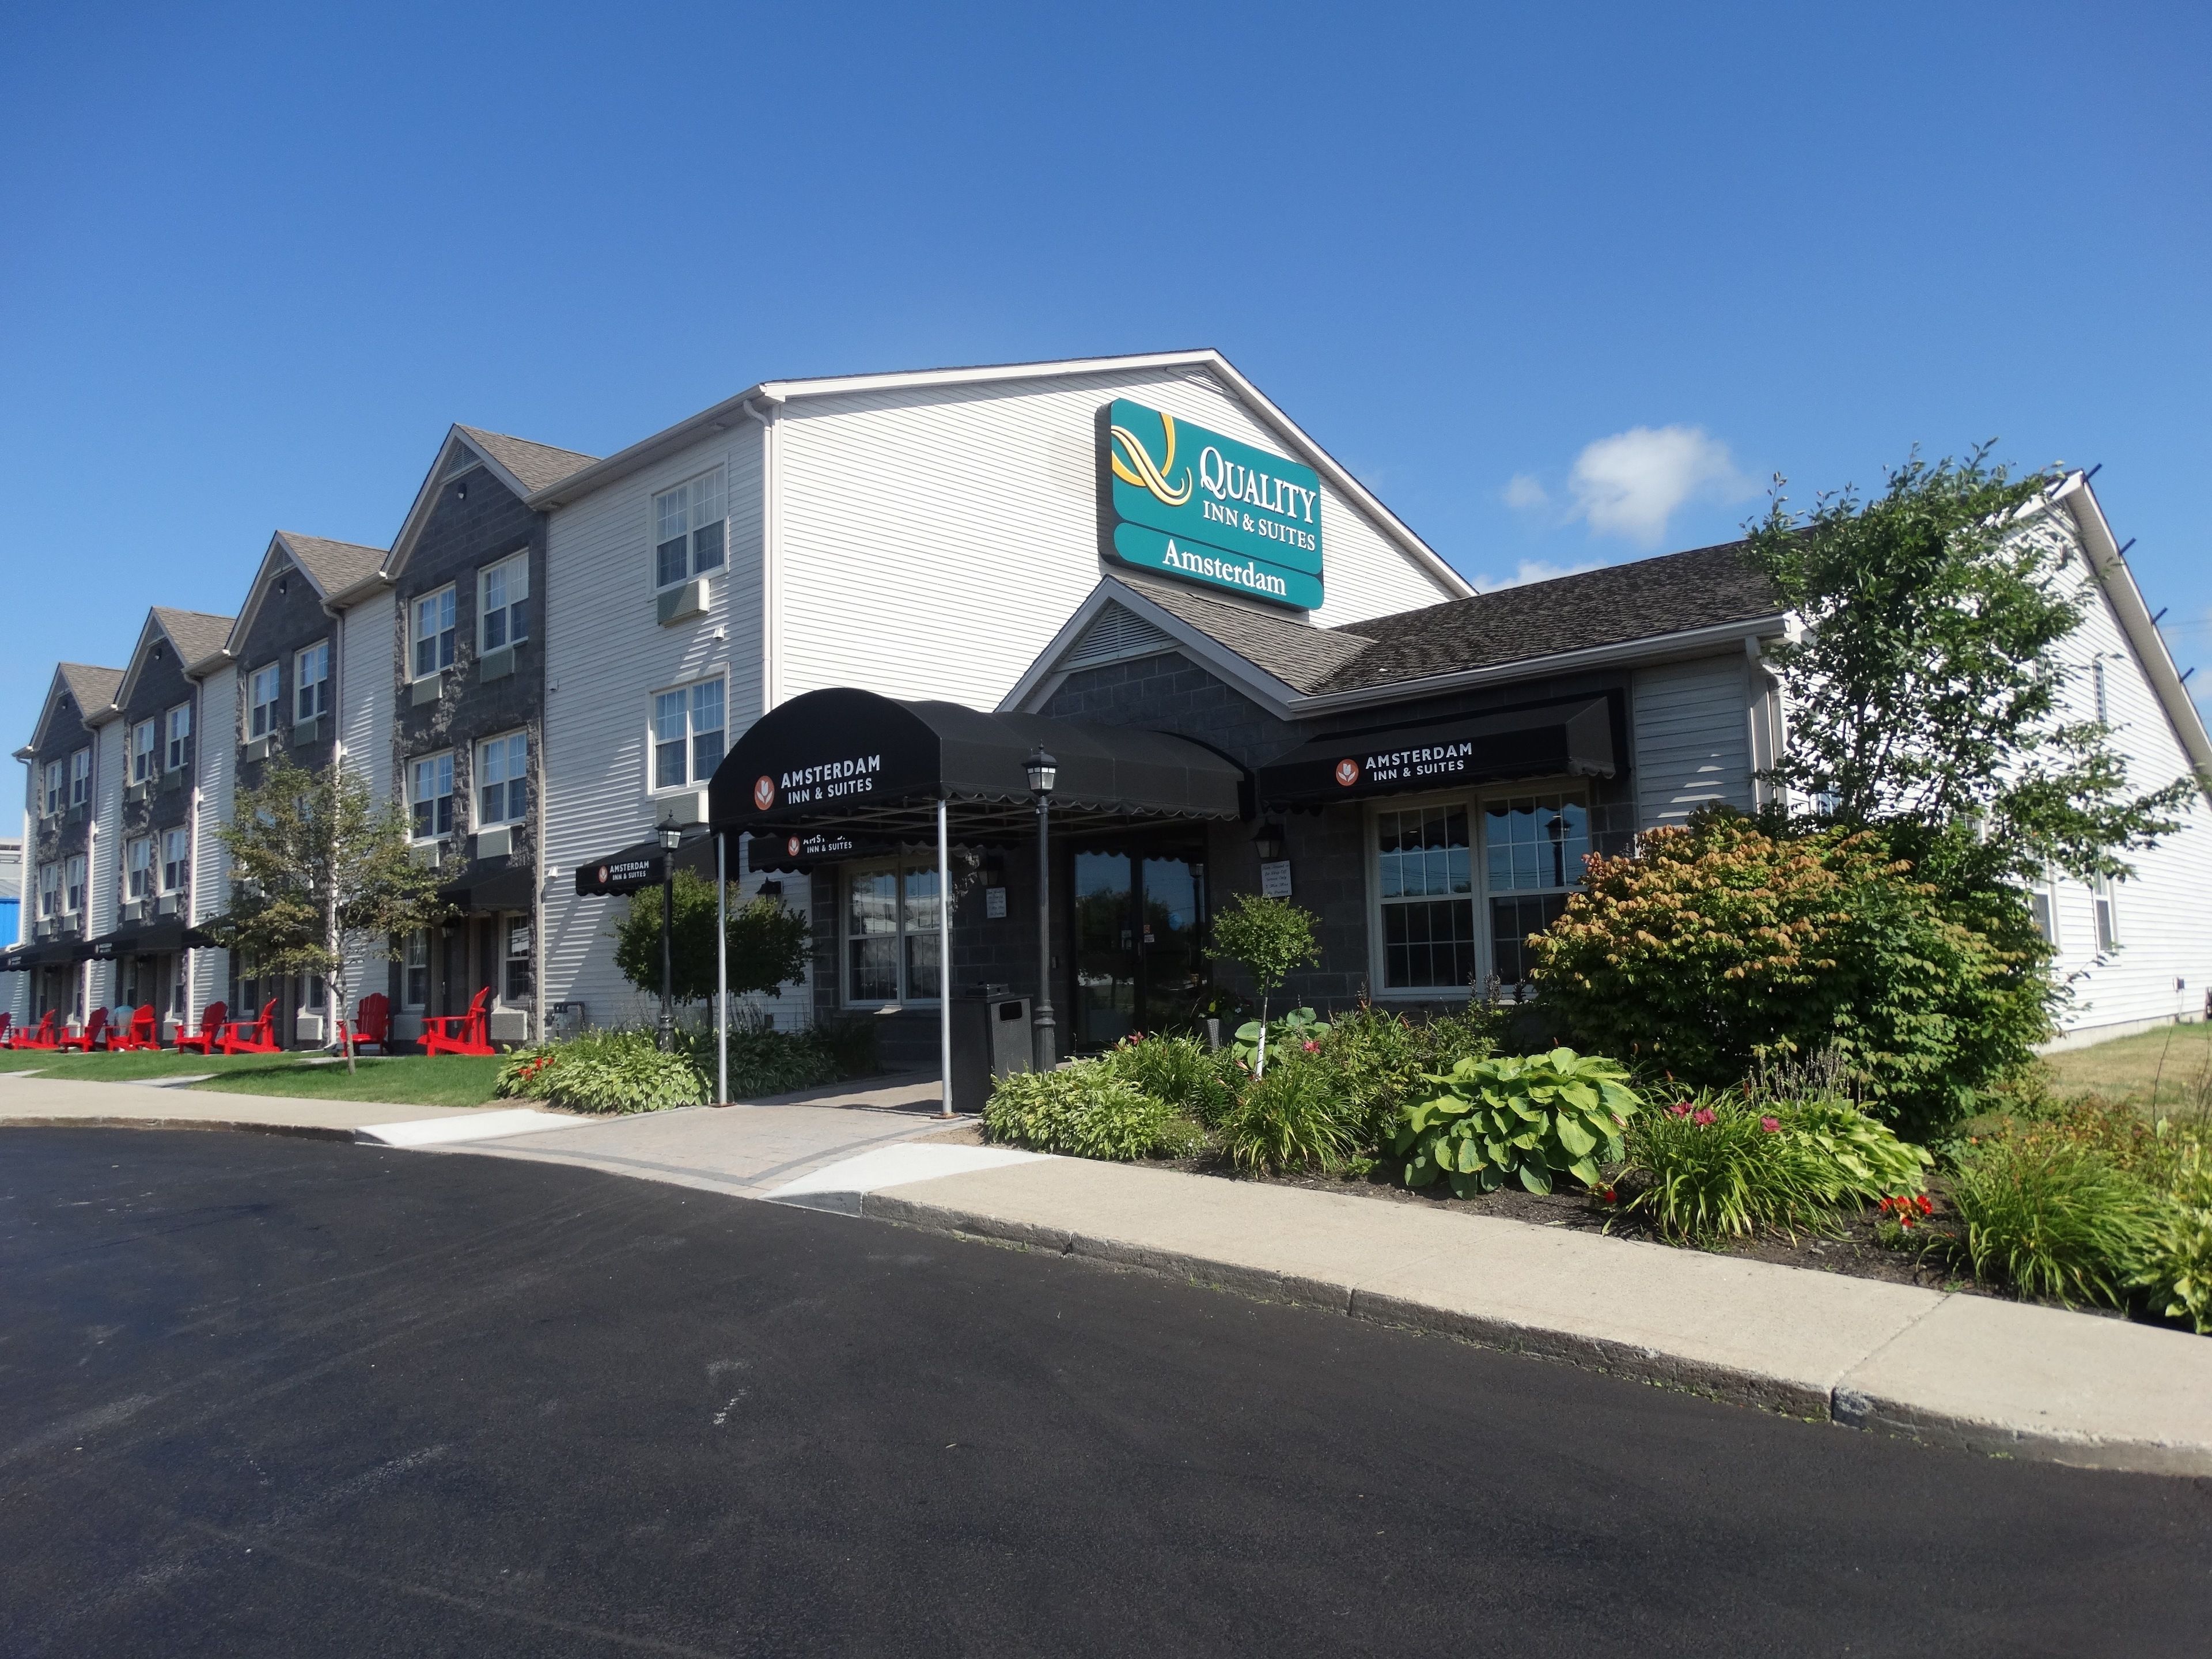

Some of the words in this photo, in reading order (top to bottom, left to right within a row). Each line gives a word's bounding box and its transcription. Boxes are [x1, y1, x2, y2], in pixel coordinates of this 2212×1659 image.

[1200, 446, 1316, 524] QUALITY
[1203, 500, 1238, 528] INN
[1244, 513, 1255, 533] &
[1259, 518, 1316, 552] SUITES
[1162, 539, 1287, 596] Amsterdam
[1365, 743, 1472, 770] AMSTERDAM
[781, 755, 880, 789] AMSTERDAM
[1374, 768, 1397, 781] INN
[1403, 767, 1411, 778] &
[1416, 760, 1464, 775] SUITES
[788, 791, 810, 805] INN
[815, 787, 823, 800] &
[828, 778, 872, 798] SUITES
[828, 842, 853, 851] SUITES
[610, 861, 649, 873] AMSTERDAM
